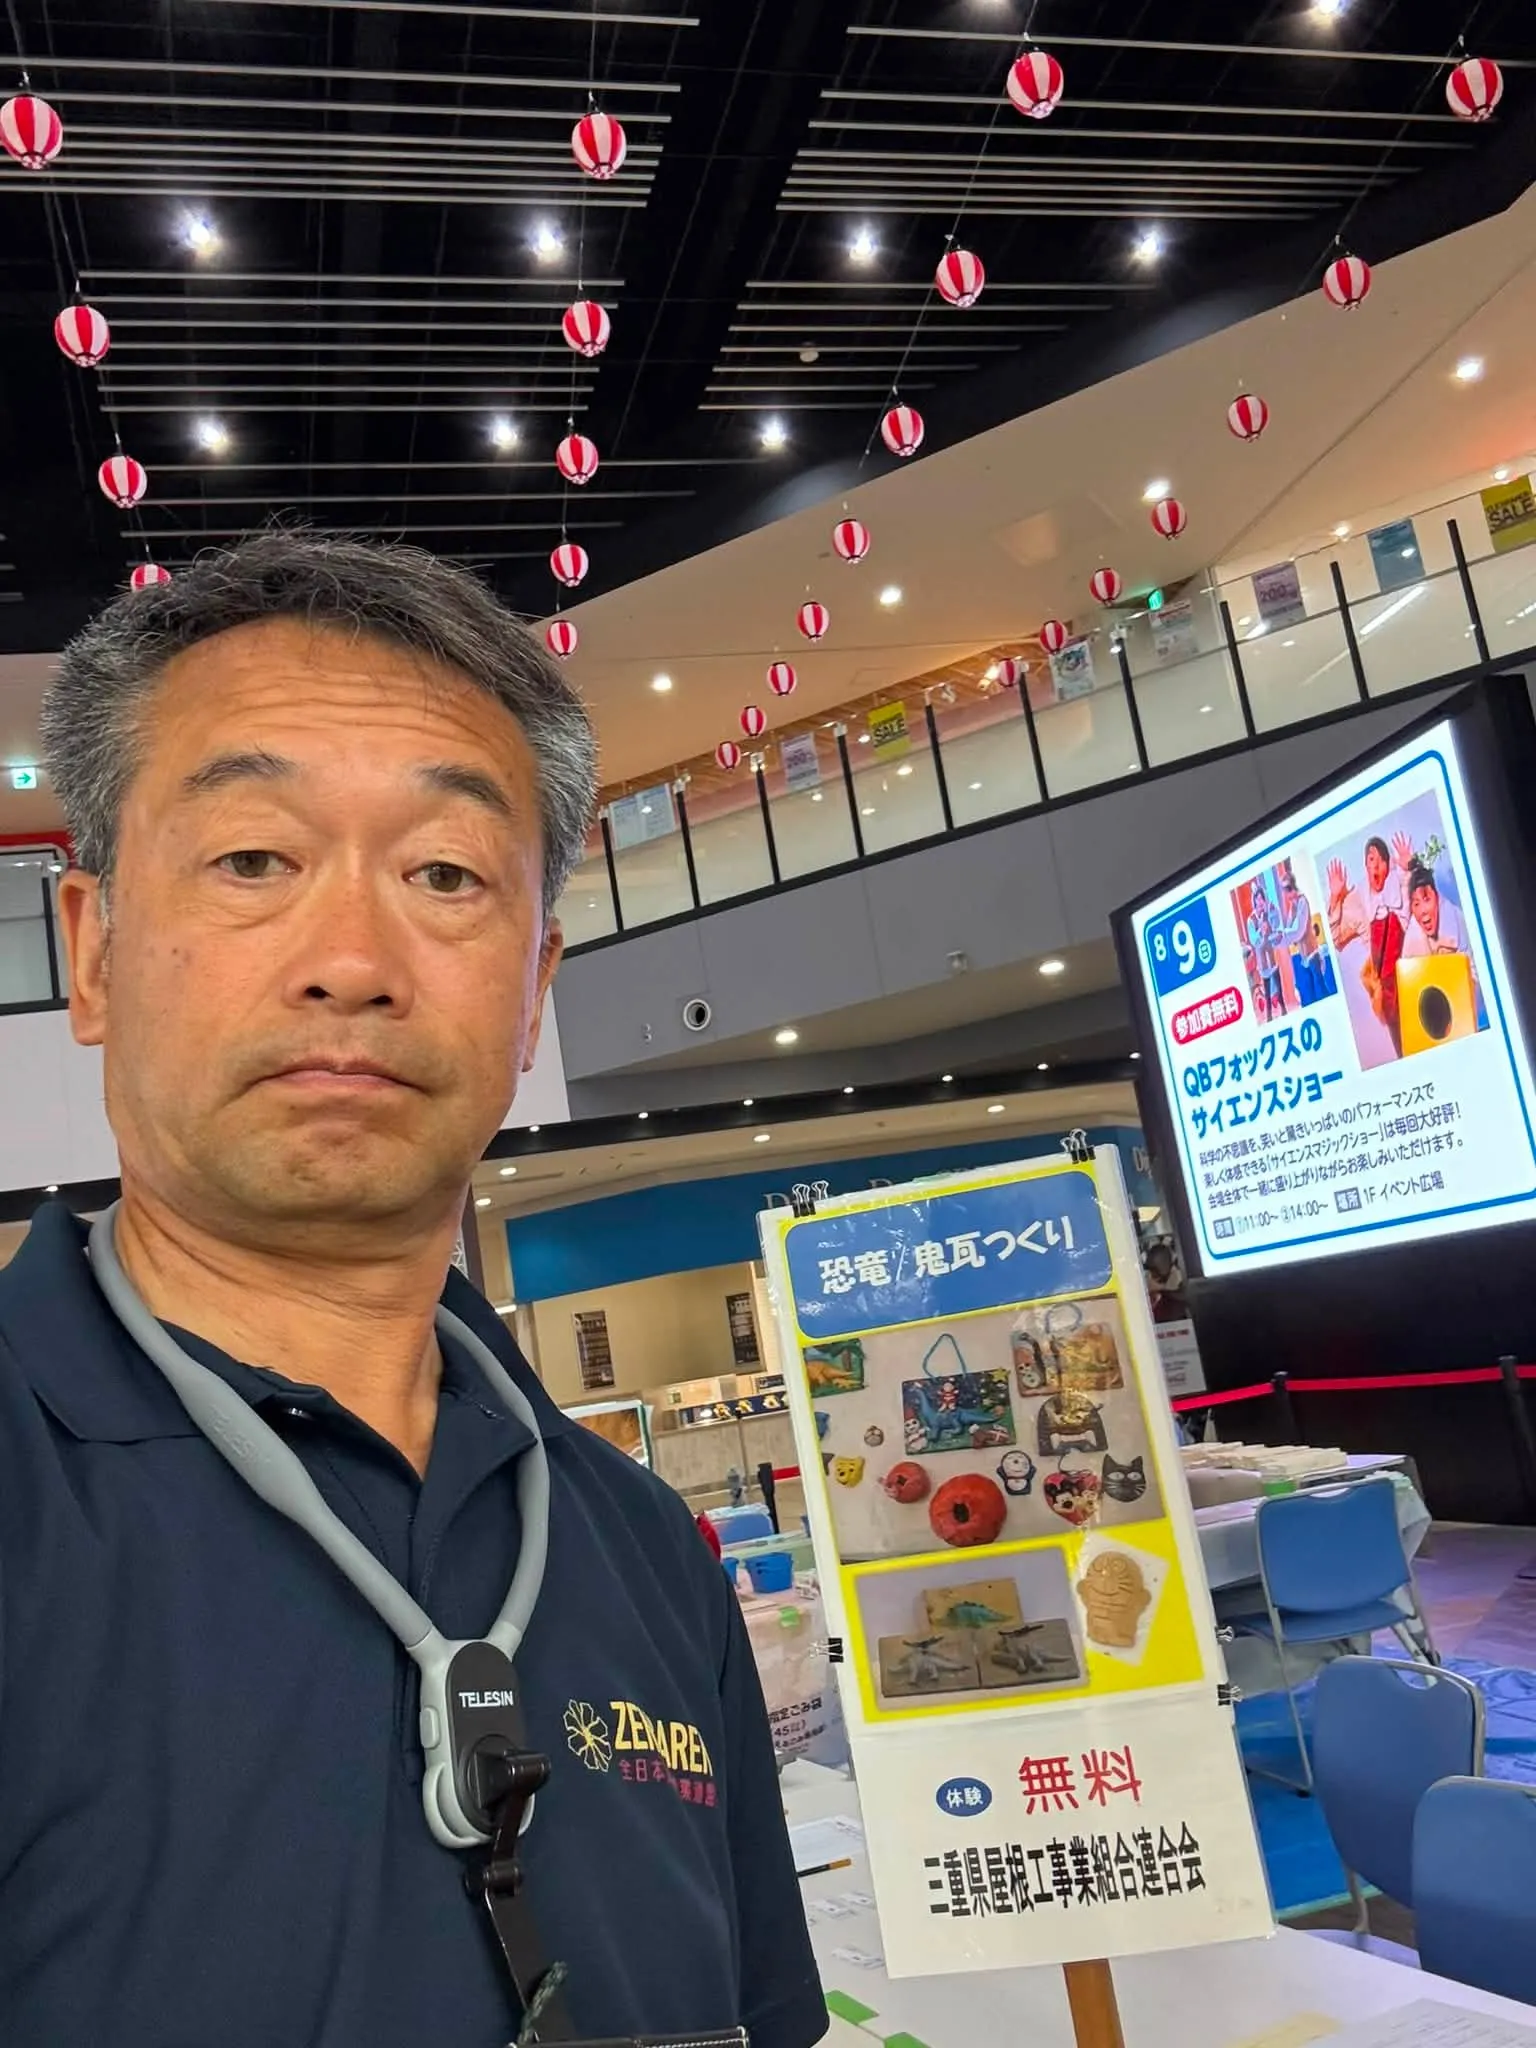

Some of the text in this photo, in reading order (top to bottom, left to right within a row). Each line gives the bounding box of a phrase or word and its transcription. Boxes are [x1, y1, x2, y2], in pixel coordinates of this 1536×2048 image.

[1489, 498, 1533, 527] SALE
[1175, 990, 1239, 1040] 参加費無料
[1183, 1018, 1322, 1098] QBフォックスの
[1191, 1070, 1343, 1139] サイエンスショー
[1380, 1170, 1444, 1201] イベント広場
[459, 1691, 514, 1708] TELESIN
[946, 1745, 1142, 1815] 体験 無料
[923, 1821, 1206, 1918] 三重県屋根工事業組合連合会
